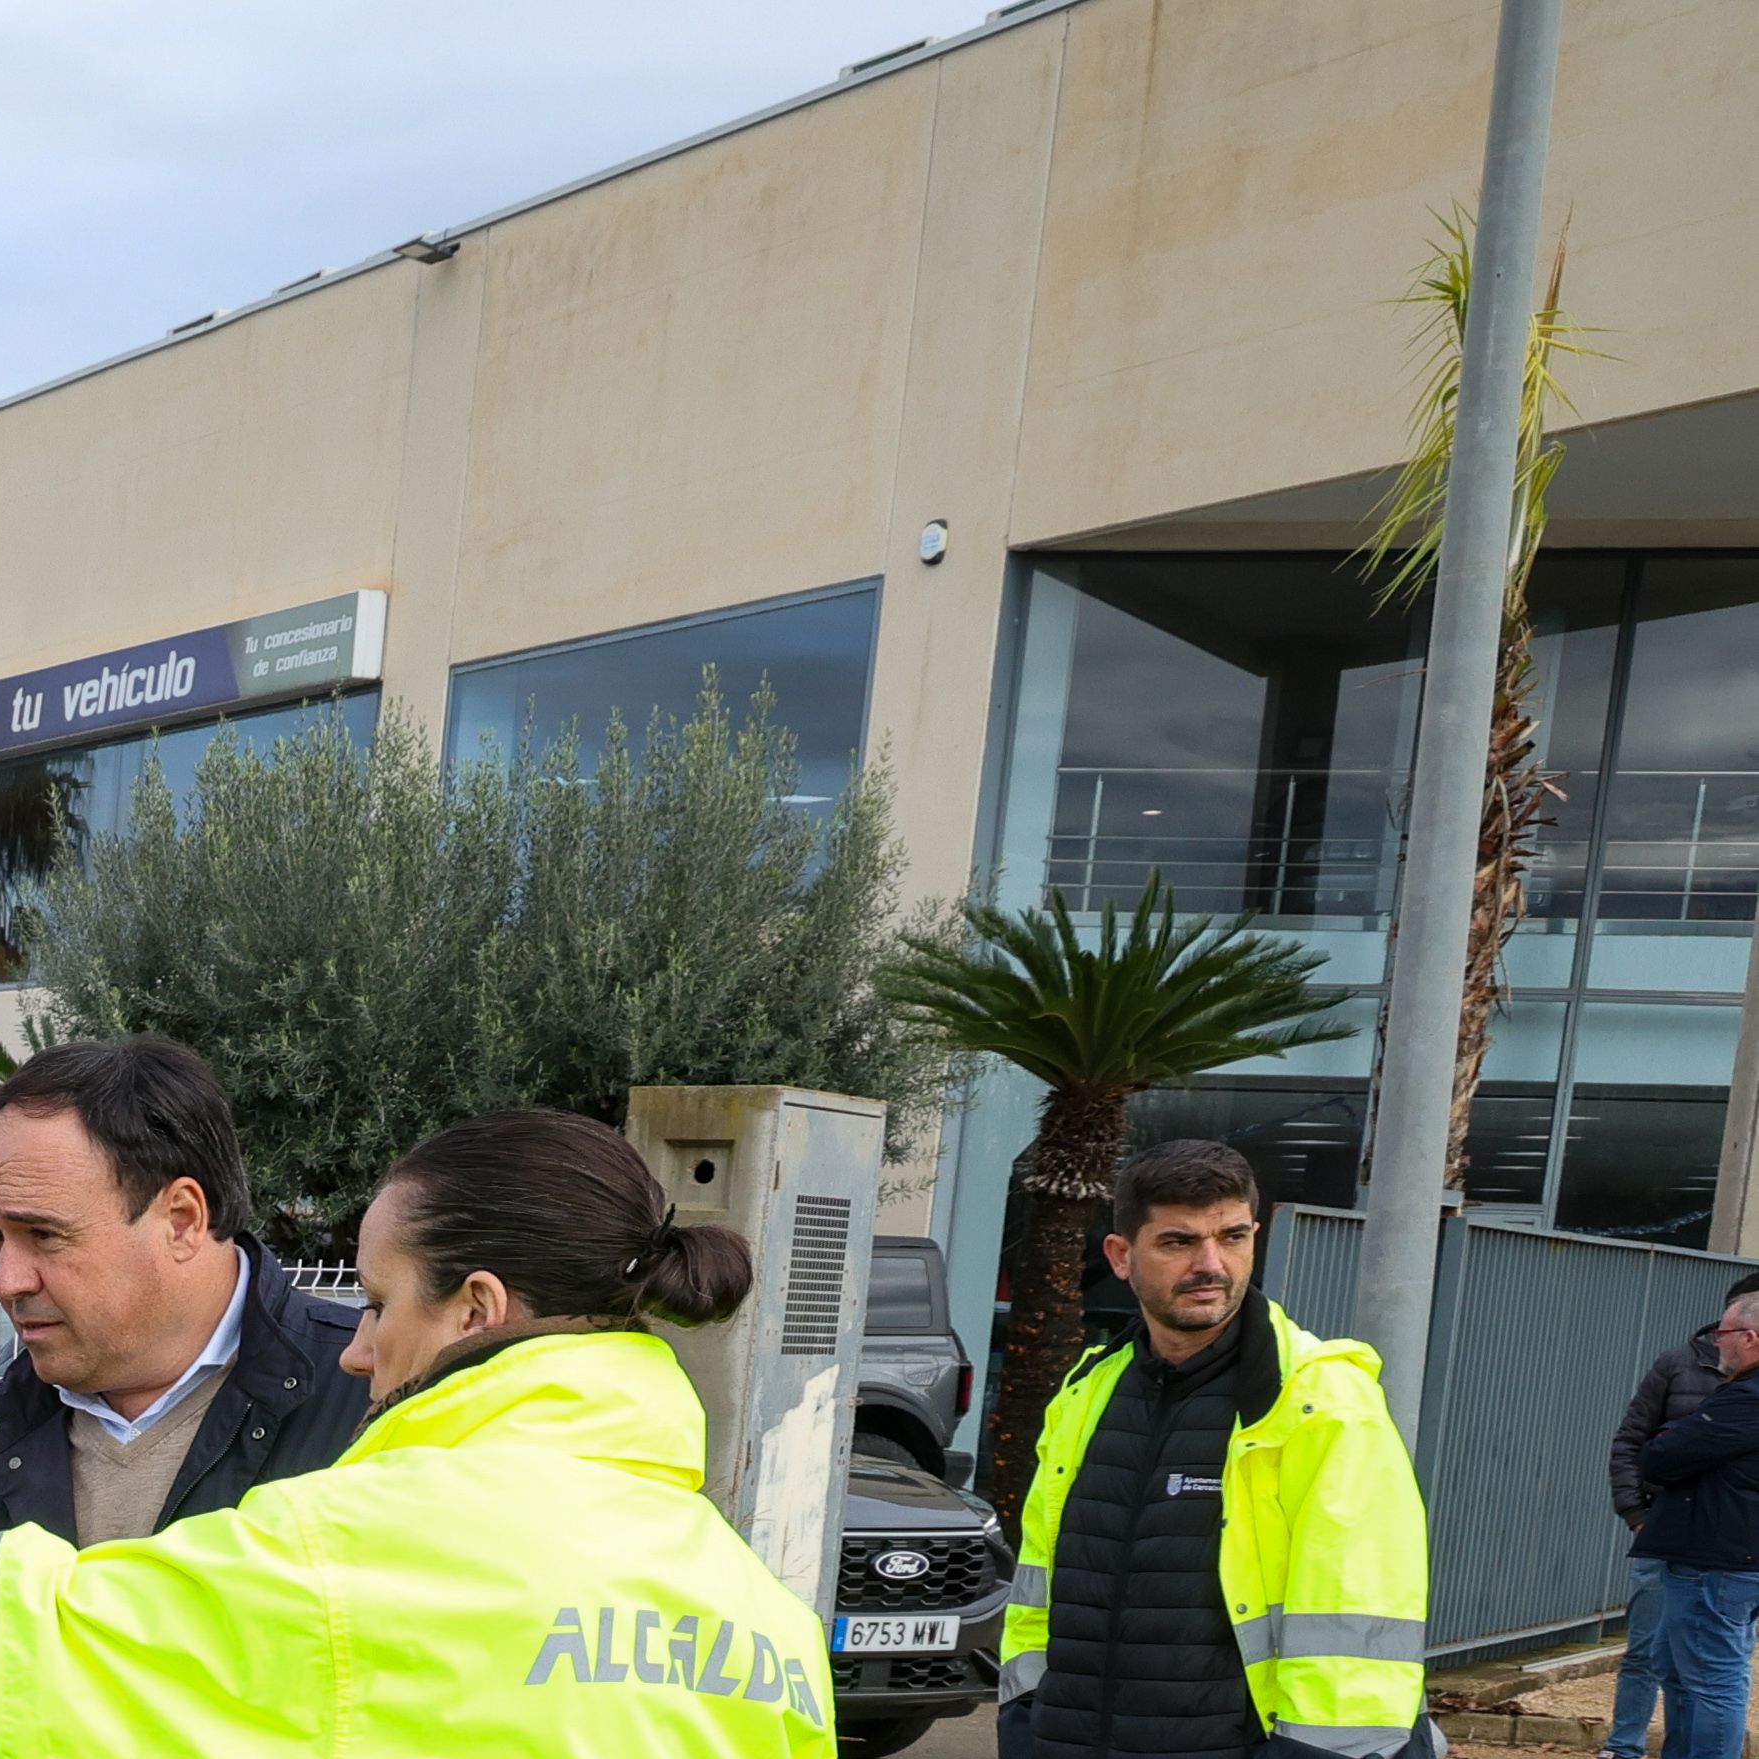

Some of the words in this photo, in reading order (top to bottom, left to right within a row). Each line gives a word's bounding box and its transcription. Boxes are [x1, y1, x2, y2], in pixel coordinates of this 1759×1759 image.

[245, 637, 259, 654] Tu
[264, 614, 353, 650] concesionario
[253, 659, 270, 678] de
[275, 646, 338, 672] confianza
[11, 686, 41, 734] tu
[63, 650, 196, 723] vehículo
[885, 1555, 920, 1574] Ford
[851, 1621, 906, 1646] 6753
[912, 1619, 950, 1646] MWL
